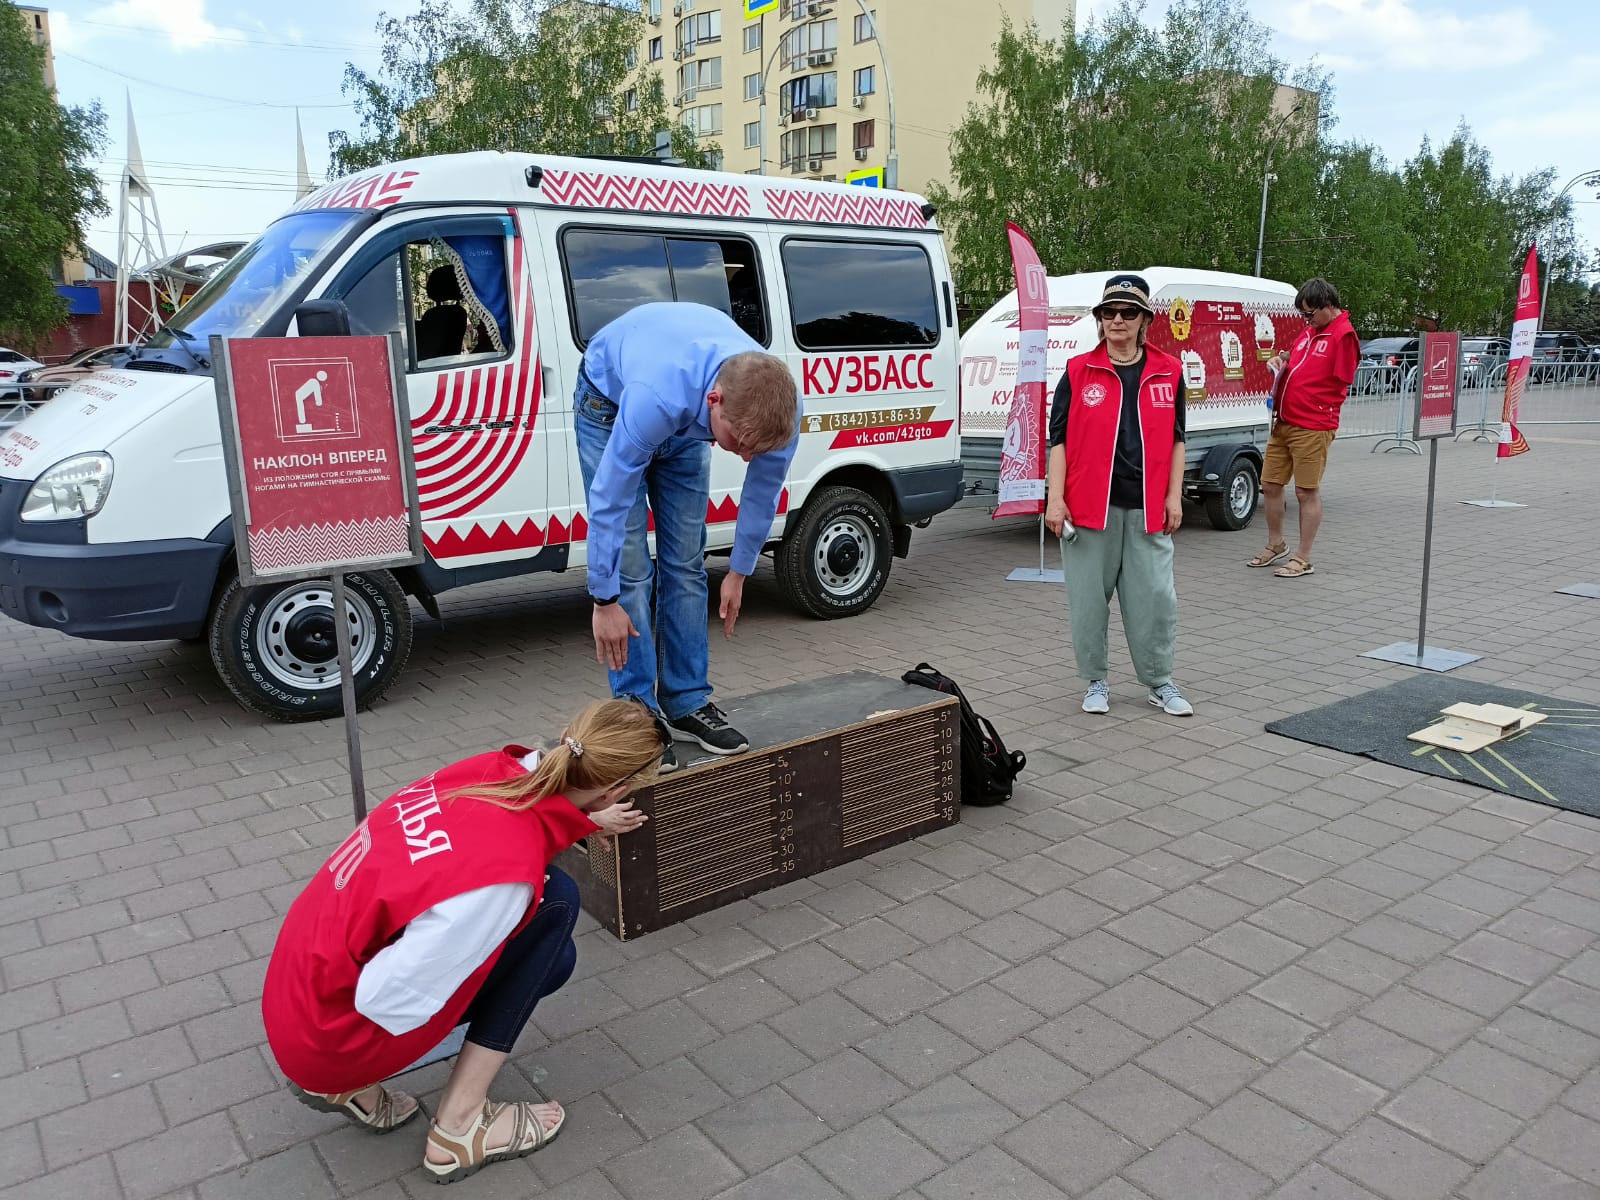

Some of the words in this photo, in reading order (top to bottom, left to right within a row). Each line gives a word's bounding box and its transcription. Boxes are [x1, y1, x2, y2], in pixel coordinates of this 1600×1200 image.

[802, 353, 934, 395] КУЗБАСС
[1149, 383, 1174, 402] ГТО
[828, 412, 868, 431] (3842)
[871, 408, 922, 423] 31-86-33
[855, 425, 932, 445] vk.com/42gto
[253, 453, 324, 471] НАКЛОН
[328, 448, 388, 465] ВПЕРЕД
[275, 473, 320, 482] ПОЛОЖЕНИЯ
[321, 470, 339, 479] СТОЯ
[255, 484, 286, 492] НОГАМИ
[299, 475, 365, 488] ГИМНАСТИЧЕСКОЙ
[364, 474, 391, 482] СКАМЬЕ
[239, 602, 308, 705] BRIDGESTONE
[941, 711, 947, 722] 5
[941, 727, 952, 739] 10
[941, 743, 952, 755] 15
[777, 755, 785, 768] 5
[941, 760, 953, 772] 20
[778, 773, 792, 786] 10
[941, 774, 953, 788] 25
[779, 791, 792, 804] 15
[942, 791, 954, 803] 30
[780, 808, 794, 822] 20
[942, 805, 954, 819] 35
[780, 825, 794, 841] 25
[781, 843, 795, 856] 30
[781, 860, 795, 873] 35
